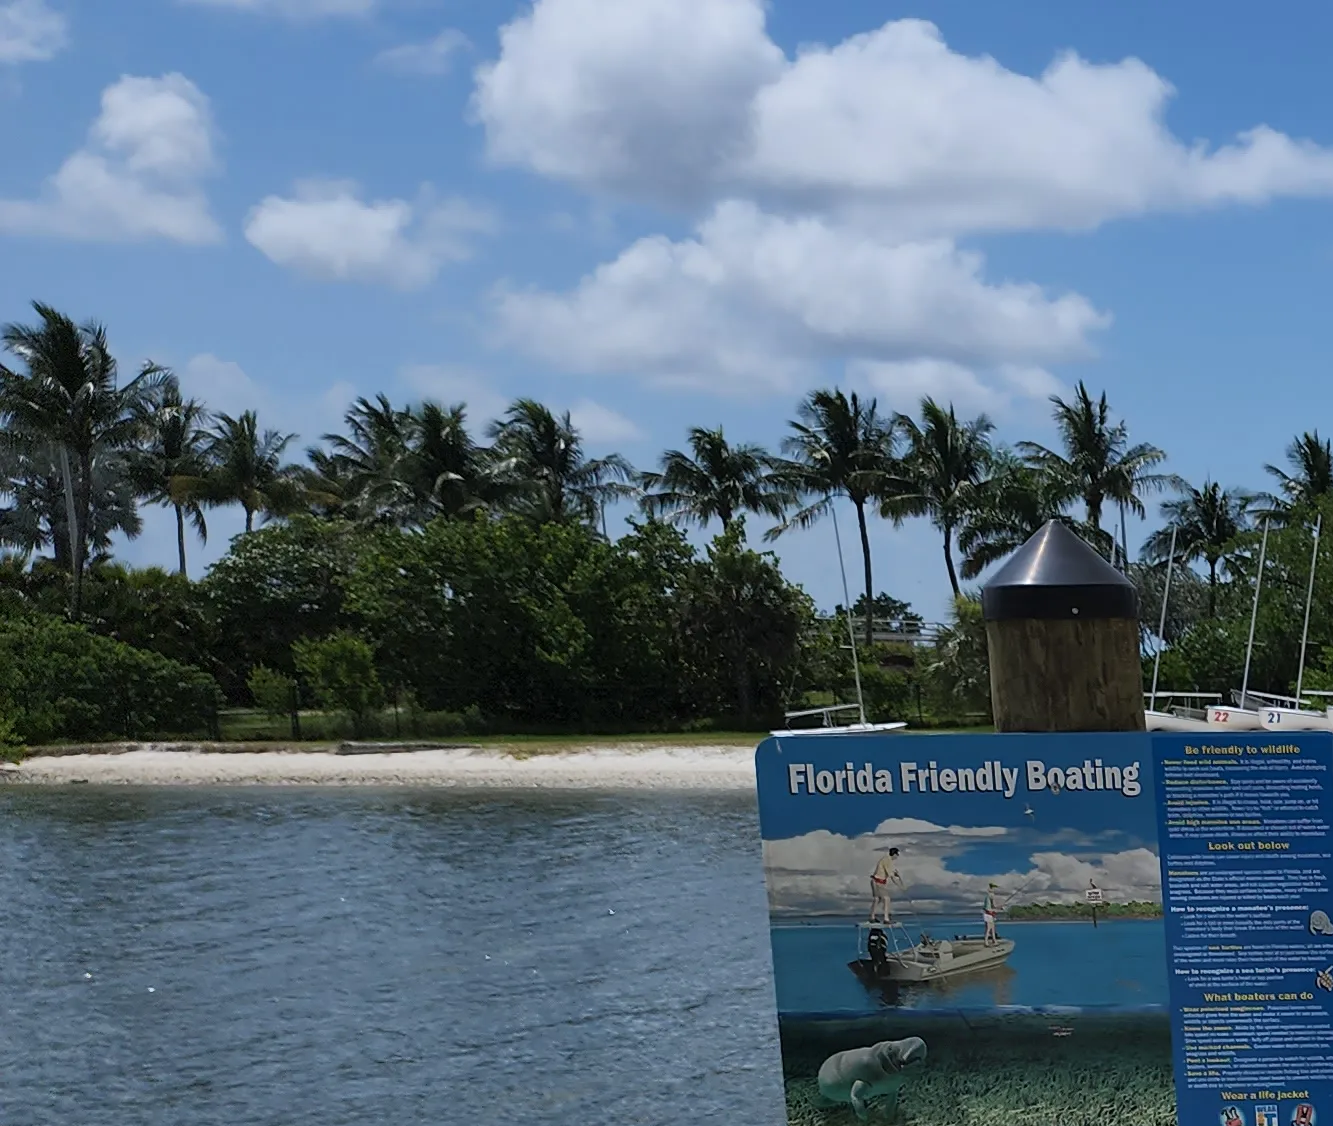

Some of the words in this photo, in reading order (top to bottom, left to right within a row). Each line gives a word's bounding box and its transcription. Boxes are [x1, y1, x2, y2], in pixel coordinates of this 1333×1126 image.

[1214, 711, 1229, 722] 22
[1268, 712, 1281, 723] 21
[1185, 745, 1199, 755] Be
[1201, 745, 1243, 756] friendly
[1246, 745, 1257, 754] to
[1260, 744, 1300, 754] wildlife
[788, 762, 893, 795] Florida
[900, 761, 1018, 798] Friendly
[1026, 759, 1141, 797] Boating
[1208, 842, 1234, 850] Look
[1237, 842, 1255, 850] out
[1258, 841, 1290, 850] below
[1204, 993, 1232, 1002] What
[1234, 993, 1275, 1001] boaters
[1300, 992, 1313, 1000] do
[1221, 1091, 1247, 1100] Wear
[1258, 1091, 1276, 1099] life
[1277, 1090, 1309, 1101] jacket
